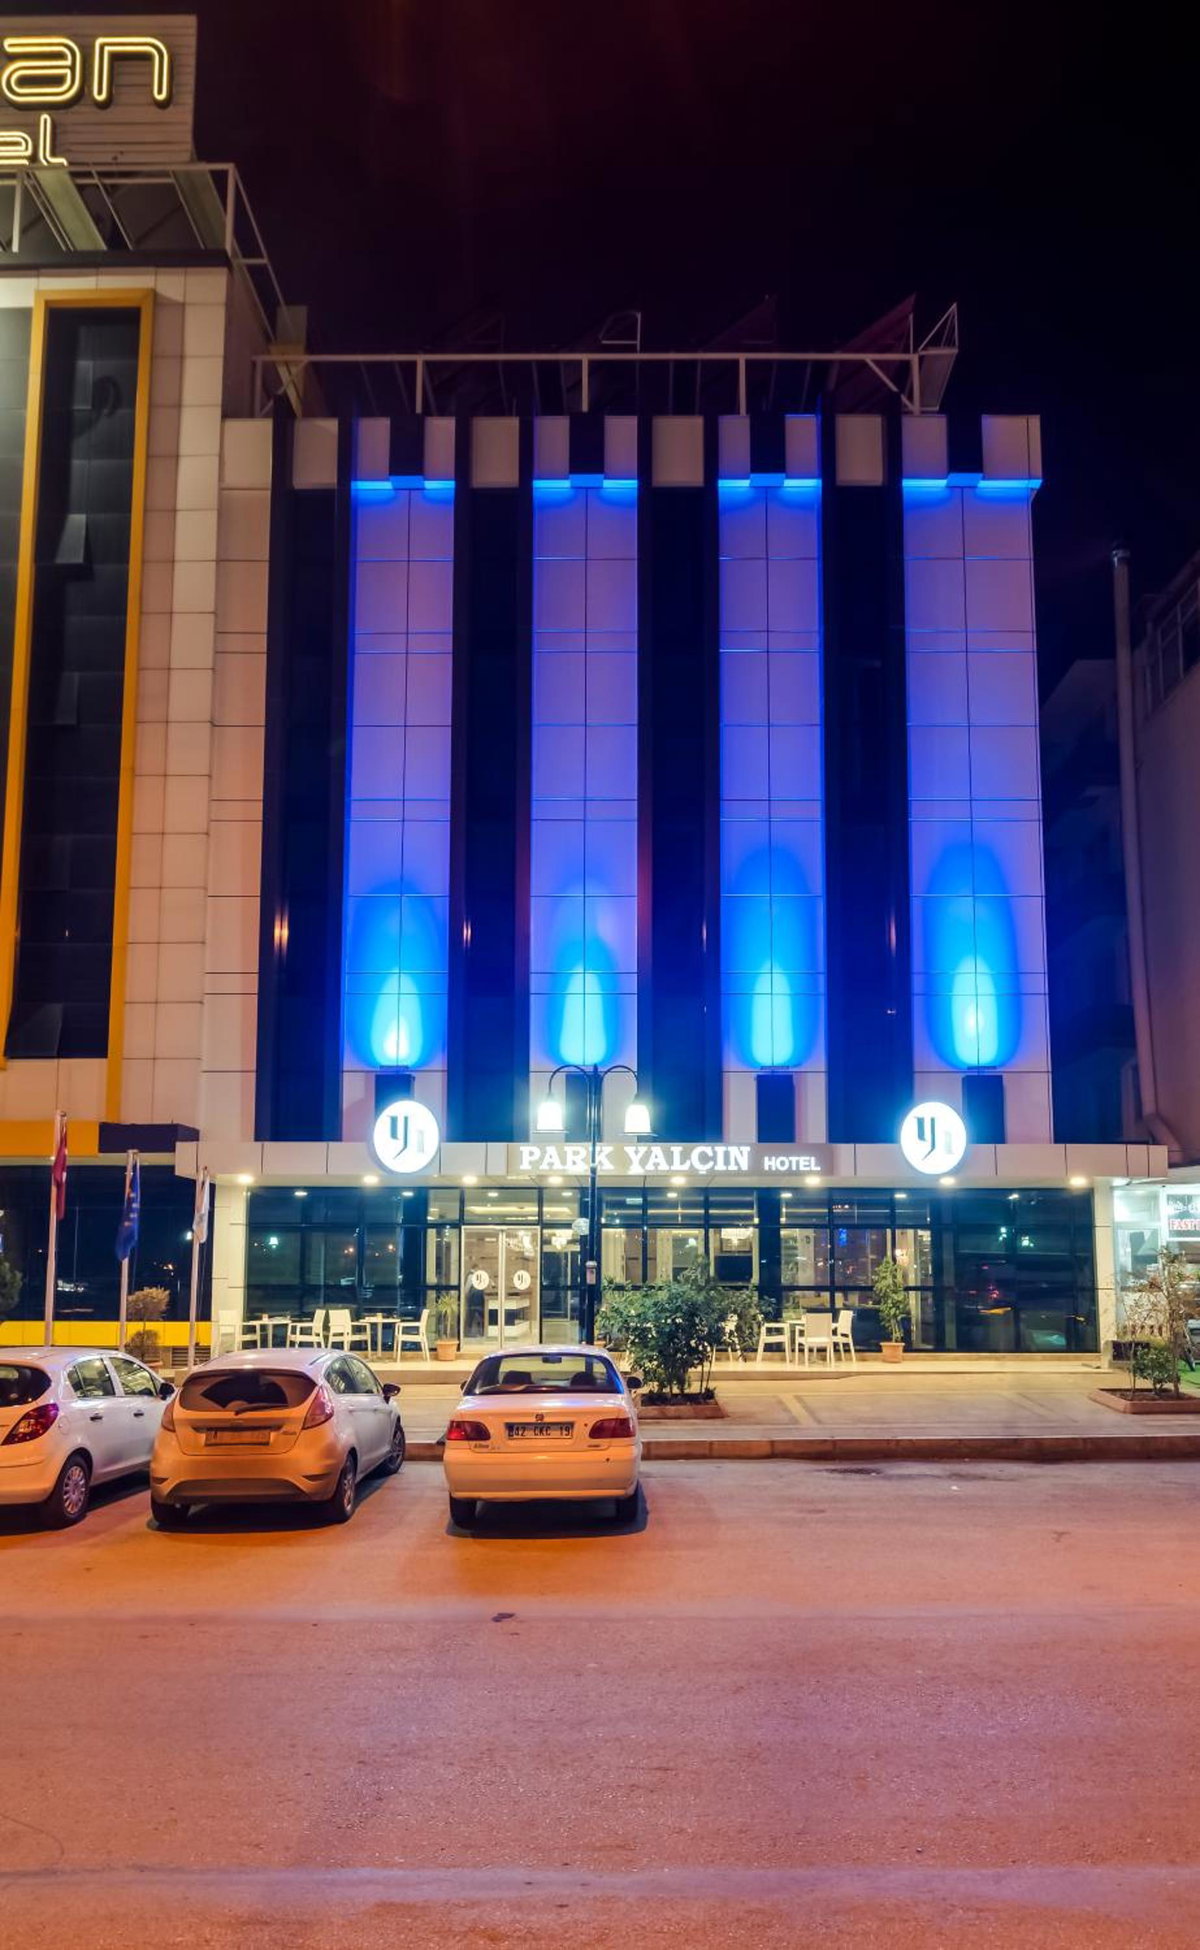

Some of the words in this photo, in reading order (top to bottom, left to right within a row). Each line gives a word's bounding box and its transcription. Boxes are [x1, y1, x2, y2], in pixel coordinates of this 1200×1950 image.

[2, 36, 168, 102] an
[519, 1145, 615, 1171] PARK
[623, 1145, 751, 1174] YALÇIN
[763, 1156, 821, 1171] HOTEL
